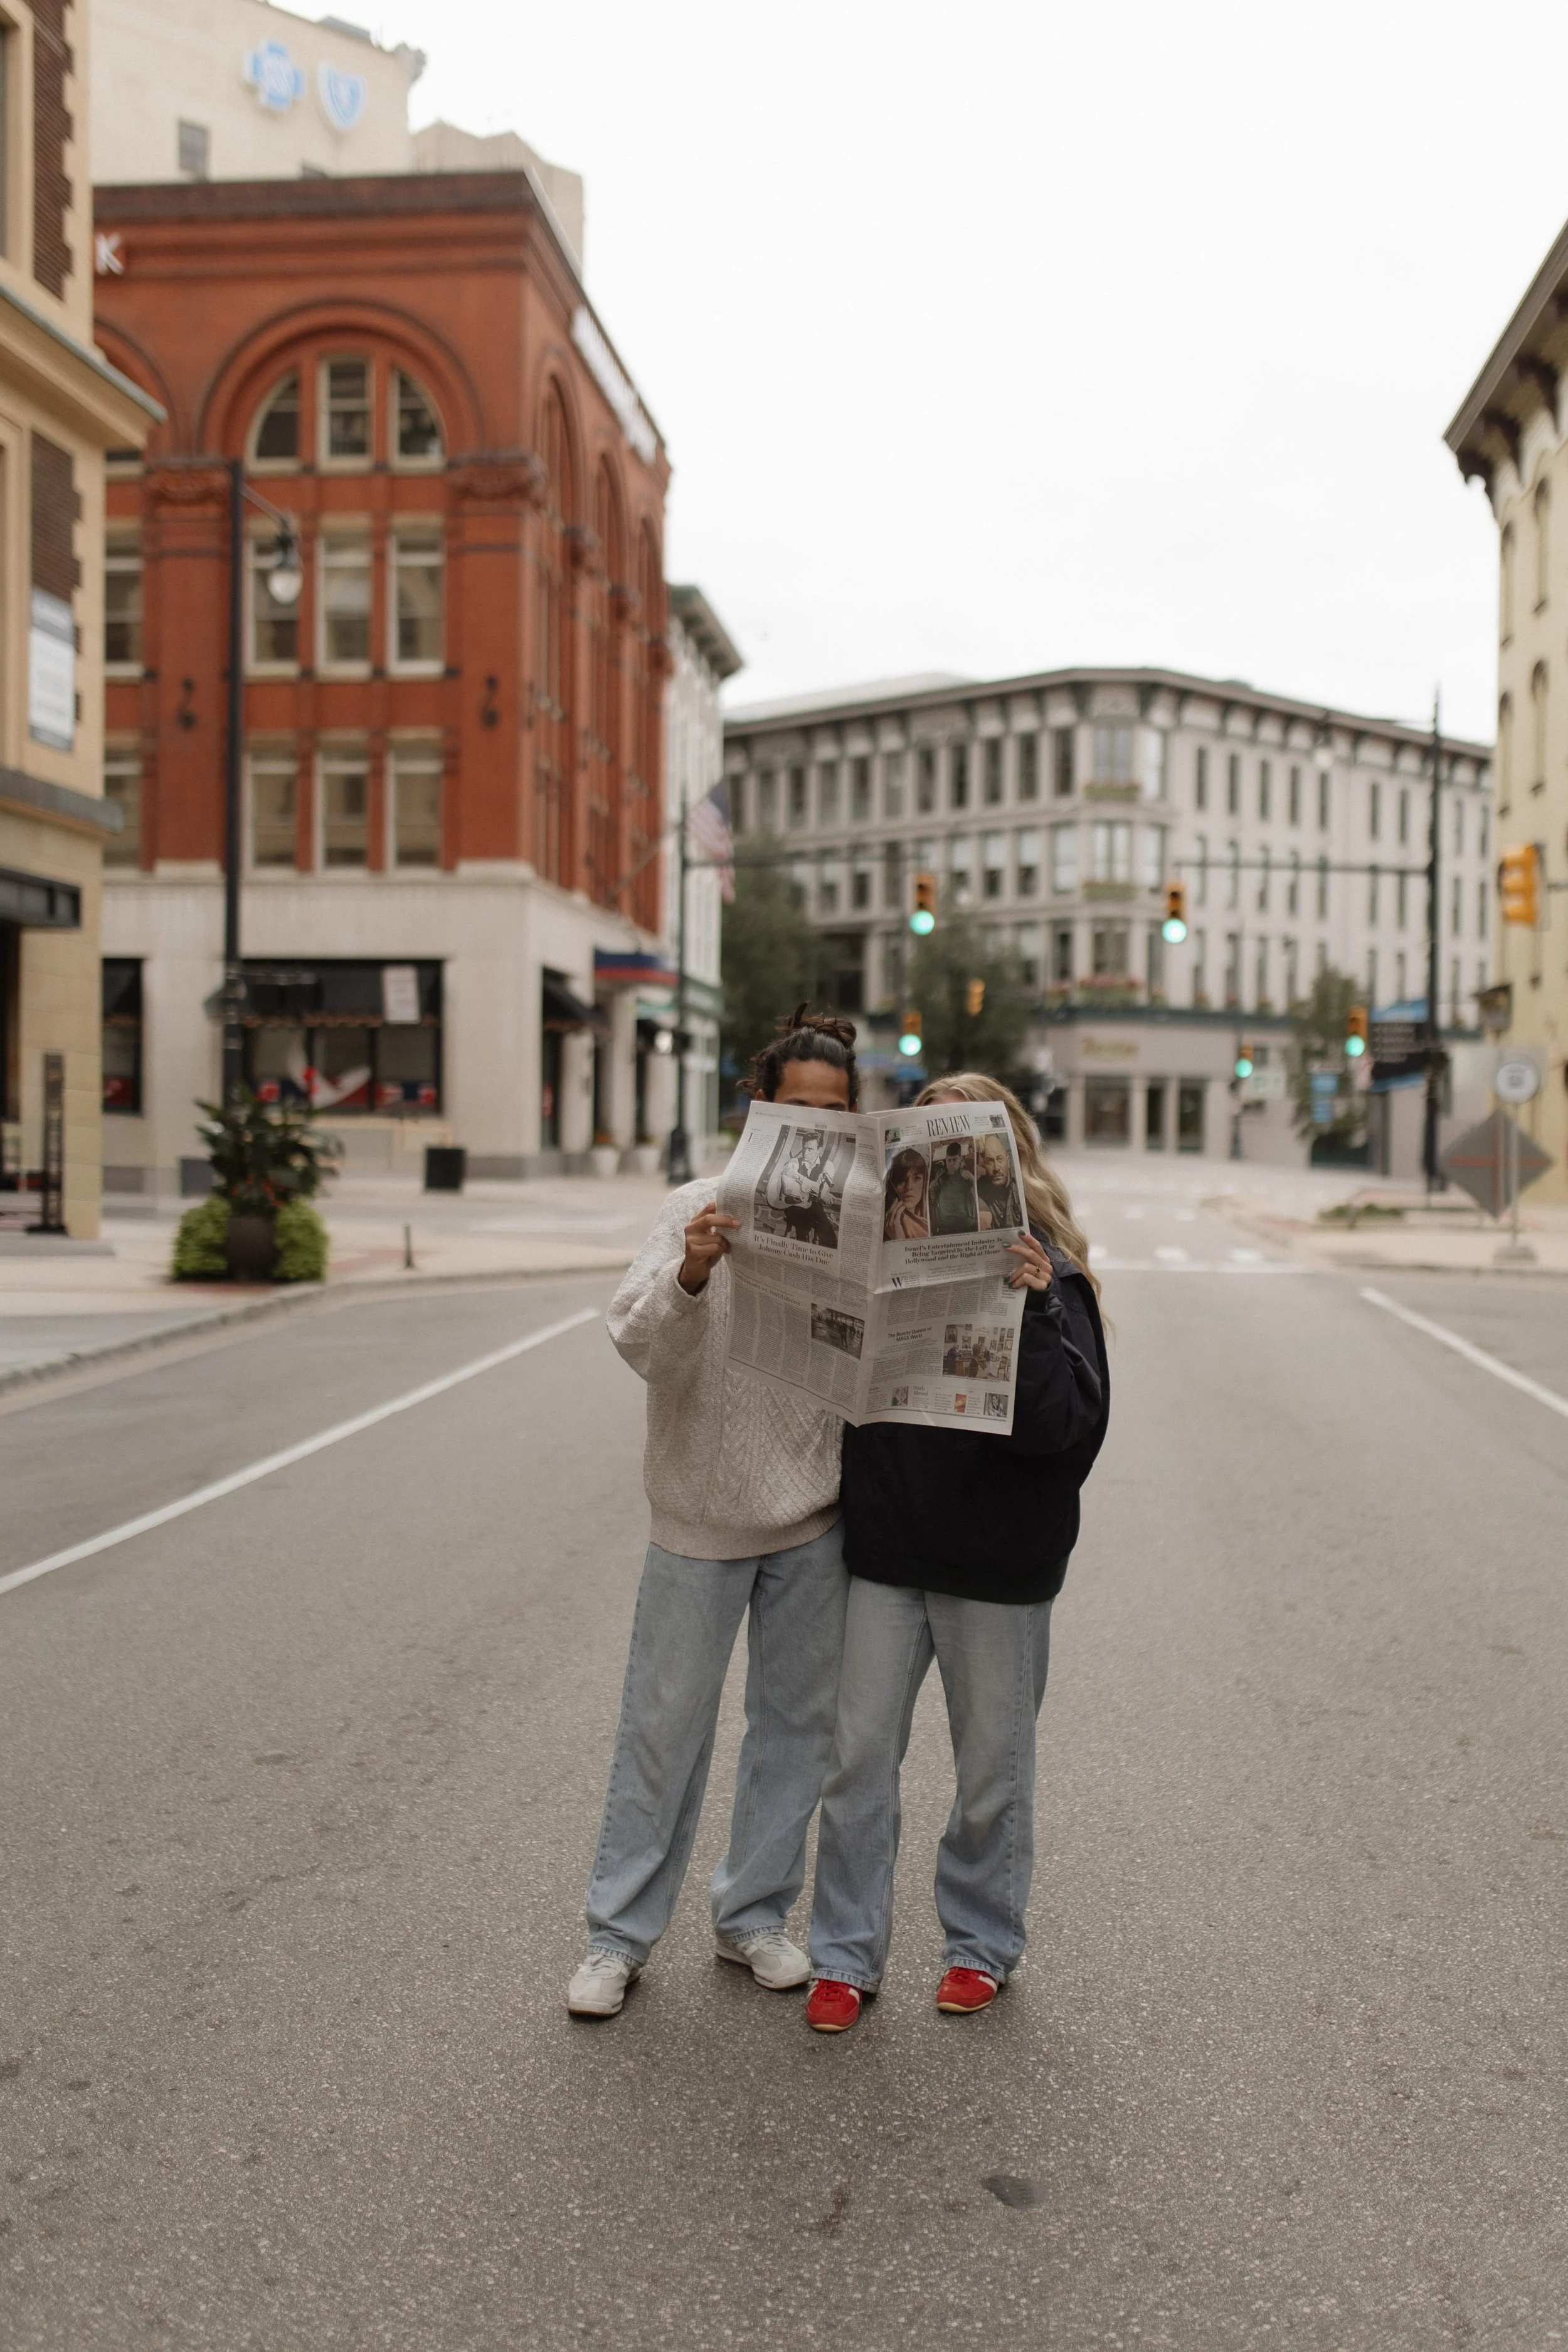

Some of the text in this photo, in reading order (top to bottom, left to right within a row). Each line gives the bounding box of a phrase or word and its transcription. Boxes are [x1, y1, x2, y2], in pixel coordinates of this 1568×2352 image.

[926, 1115, 971, 1137] REVIEW
[766, 1237, 788, 1249] Finally
[791, 1243, 809, 1253] Time
[818, 1250, 834, 1258] Give
[928, 1241, 970, 1250] Entertainment
[931, 1248, 956, 1256] Targeted
[758, 1244, 830, 1265] Johnny Cash His Due
[905, 1256, 936, 1265] Hollywood
[960, 1251, 975, 1259] Right
[770, 1290, 801, 1306] Institutions
